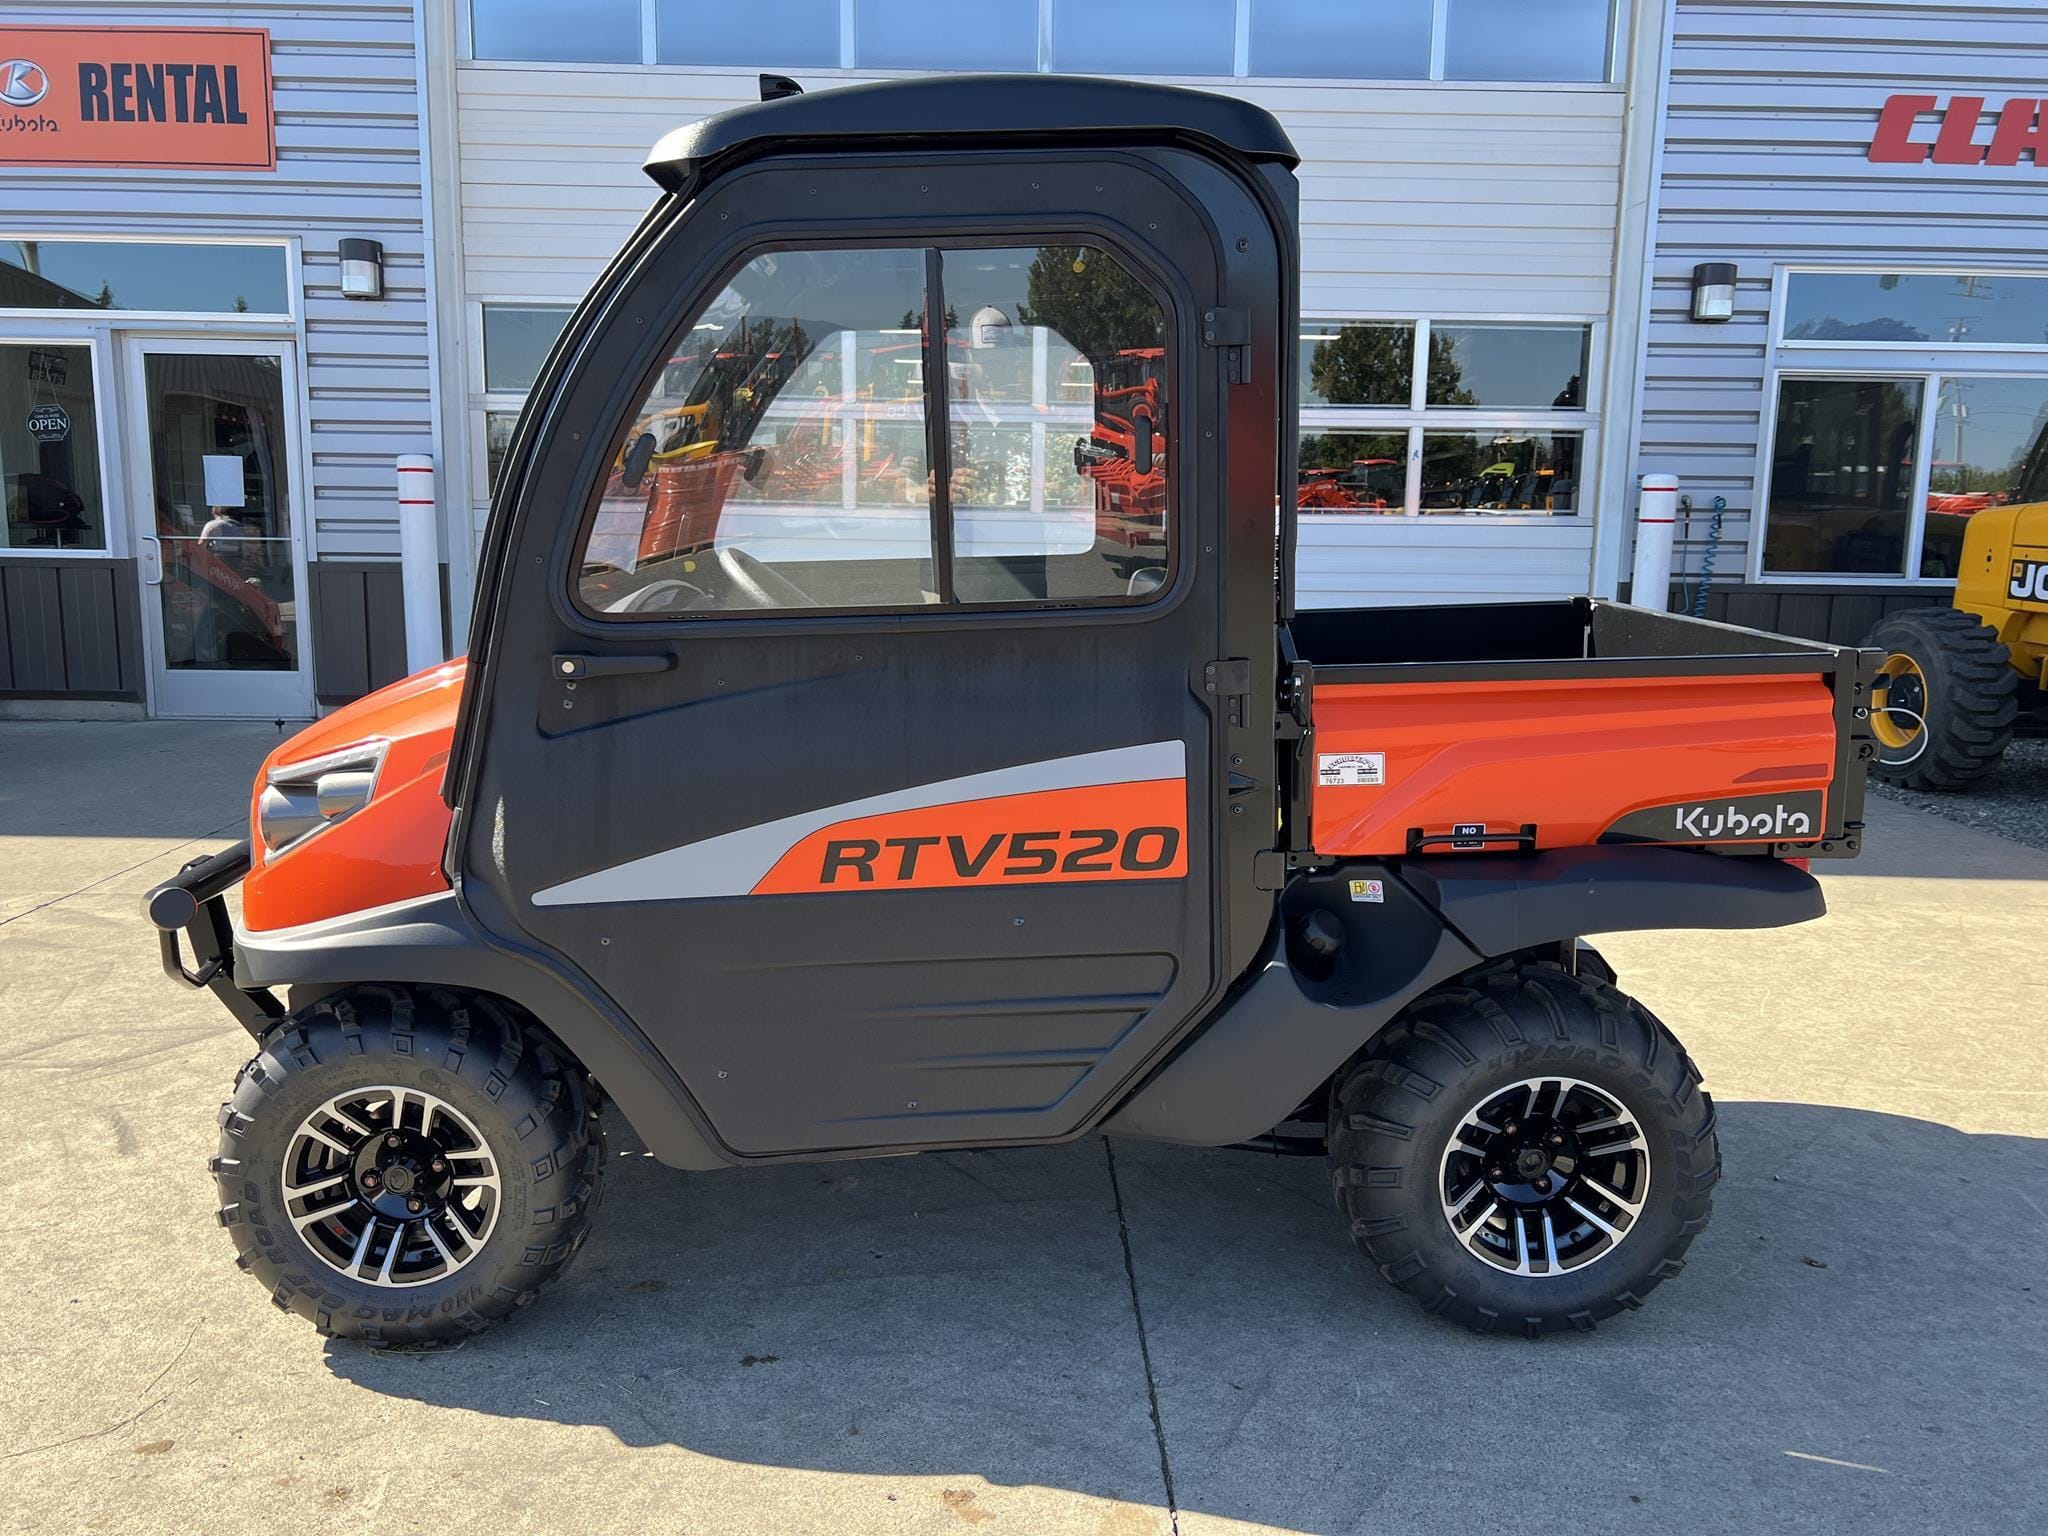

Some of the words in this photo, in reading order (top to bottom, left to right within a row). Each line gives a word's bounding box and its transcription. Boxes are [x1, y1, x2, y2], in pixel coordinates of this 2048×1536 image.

[78, 62, 248, 125] RENTAL
[0, 114, 58, 132] ubota
[28, 417, 67, 431] OPEN
[1462, 827, 1477, 835] NO
[1675, 804, 1810, 837] Kubota
[819, 826, 1180, 884] RTV520
